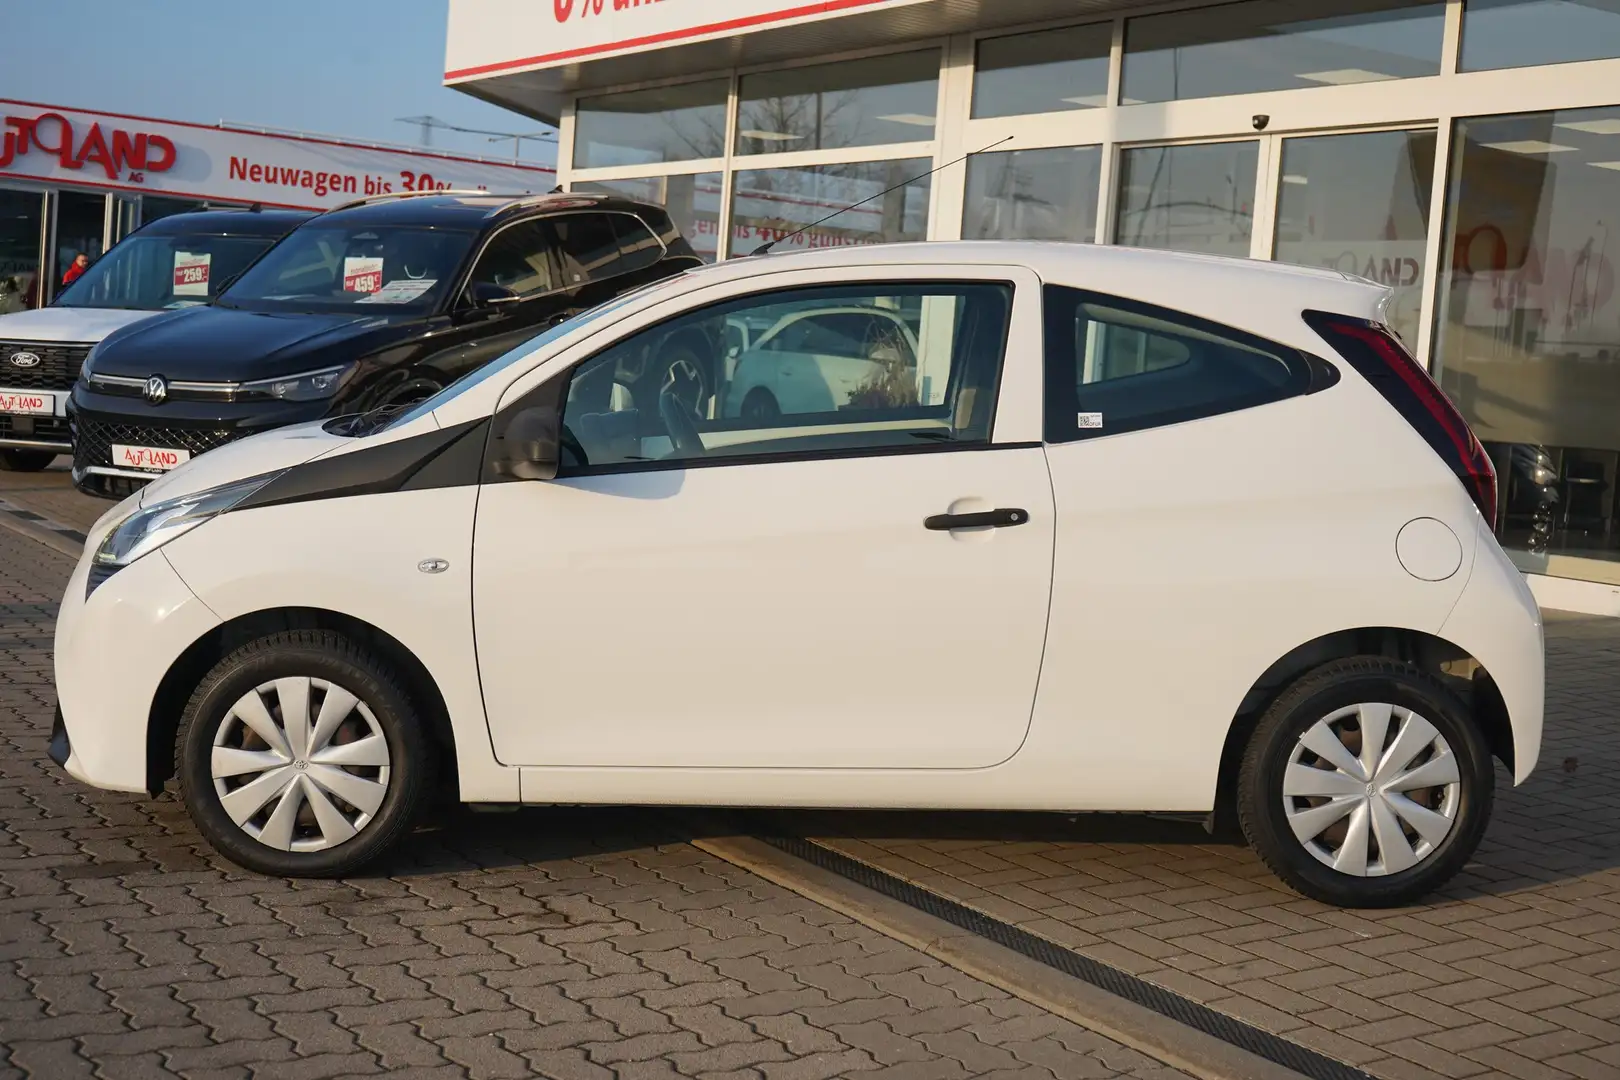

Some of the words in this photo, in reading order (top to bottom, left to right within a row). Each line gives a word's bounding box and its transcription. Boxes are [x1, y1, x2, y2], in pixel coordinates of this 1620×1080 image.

[128, 172, 144, 183] AG
[229, 156, 357, 197] Neuwagen
[364, 175, 392, 195] bis
[15, 354, 34, 365] Ford
[125, 448, 178, 468] AUTOLAND
